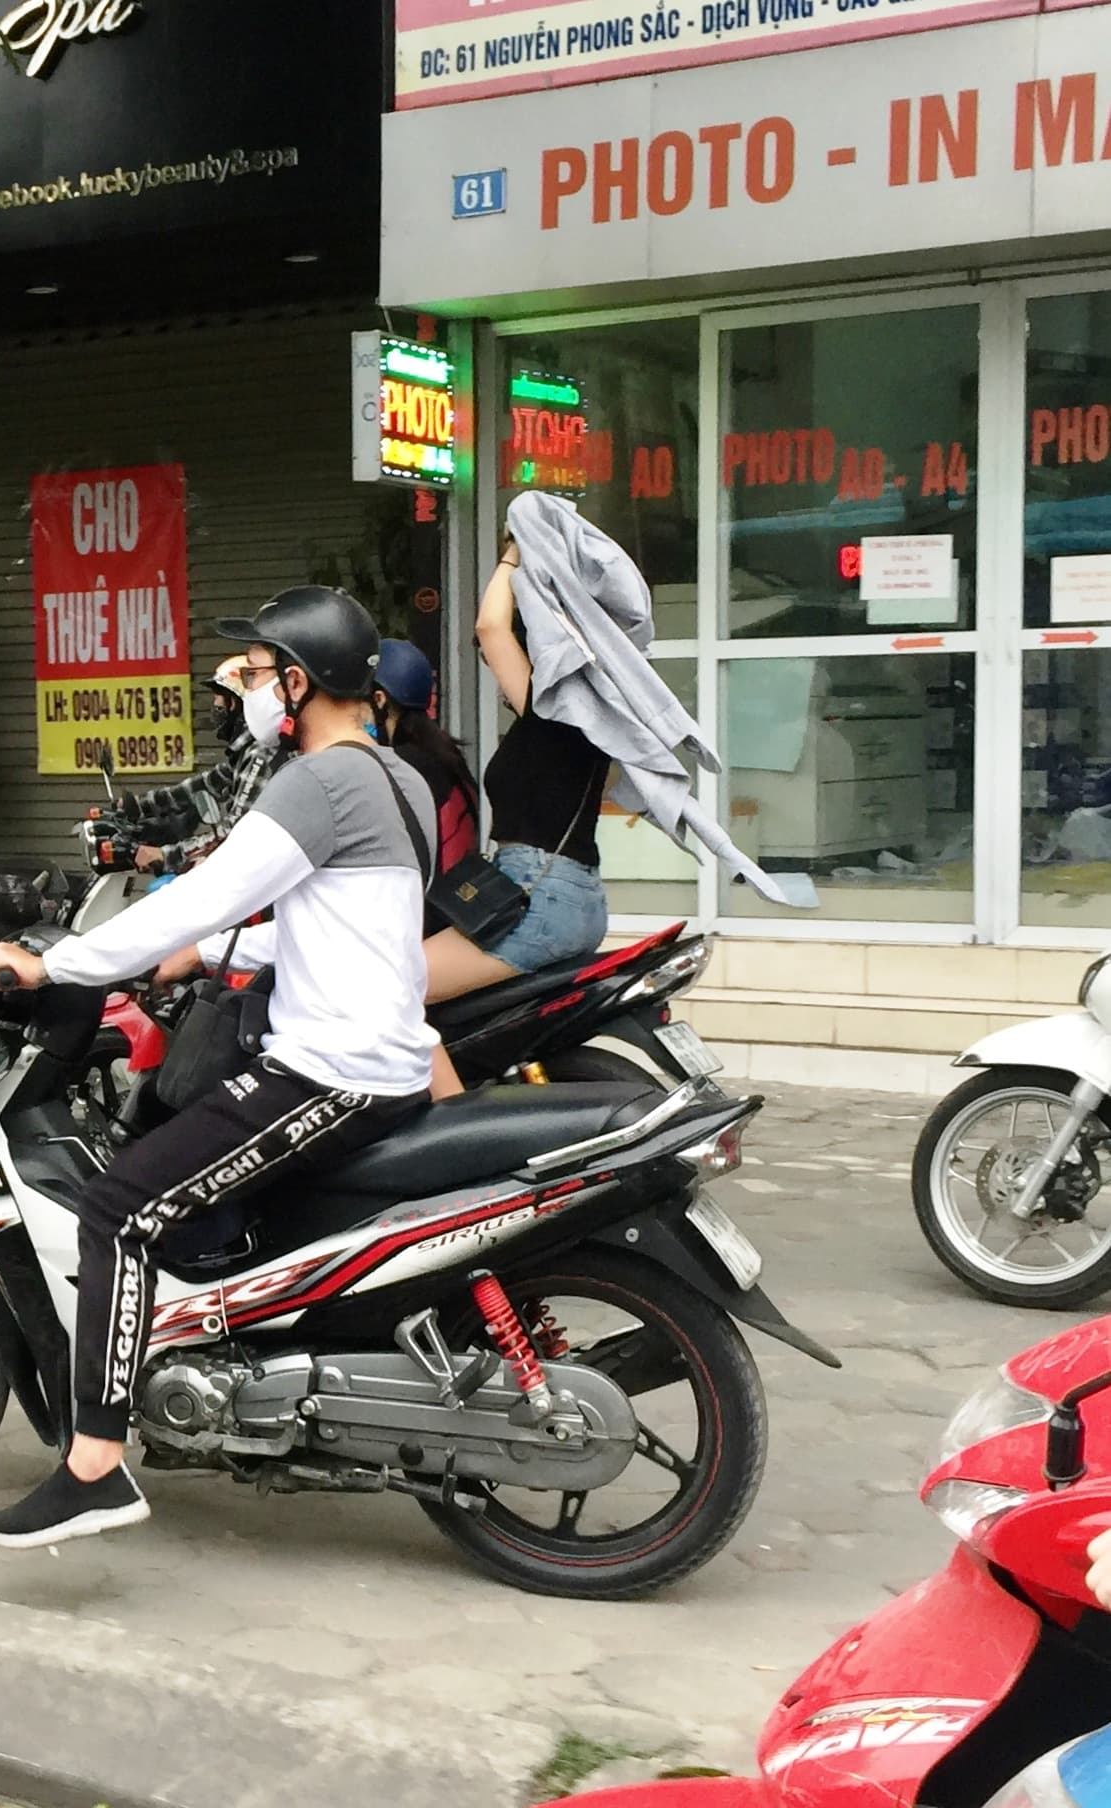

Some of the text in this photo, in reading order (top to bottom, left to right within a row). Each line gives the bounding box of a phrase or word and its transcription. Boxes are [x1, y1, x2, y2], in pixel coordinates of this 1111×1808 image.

[456, 43, 477, 72] 61
[484, 20, 561, 69] NGUYỄN
[567, 16, 634, 55] PHONG
[540, 116, 796, 231] PHOTO
[888, 88, 980, 187] IN
[1013, 71, 1111, 172] M
[461, 176, 495, 209] 61
[382, 379, 451, 443] PHOTO
[1031, 403, 1111, 467] PHO
[722, 427, 835, 487] PHOTO
[920, 440, 967, 497] A4
[72, 478, 141, 556] CHO
[42, 569, 178, 665] THUÊ NHÀ
[44, 690, 69, 723] LH:
[71, 688, 111, 722] 0904
[115, 687, 146, 721] 476
[117, 735, 159, 768] 9898
[188, 1148, 266, 1200] FIGHT
[417, 1212, 530, 1252] SIRIUS
